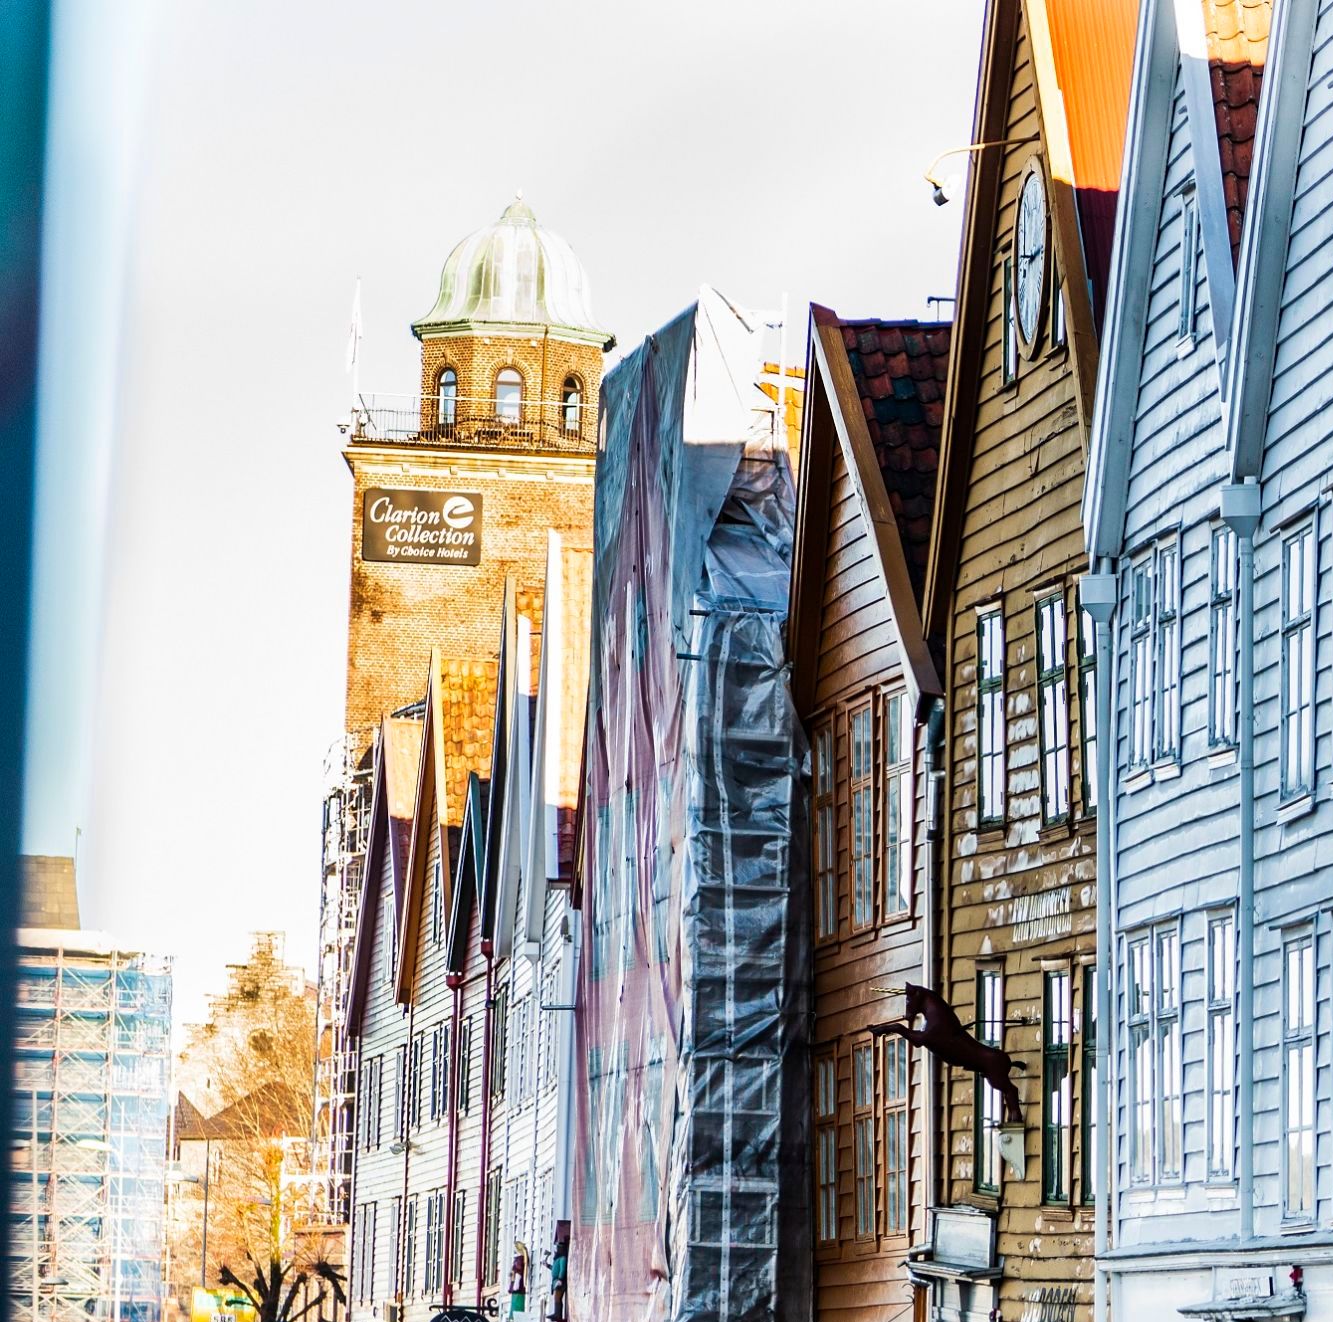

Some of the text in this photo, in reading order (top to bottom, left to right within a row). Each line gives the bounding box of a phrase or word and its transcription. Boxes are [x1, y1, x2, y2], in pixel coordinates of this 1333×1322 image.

[370, 496, 440, 525] Clarion
[385, 525, 475, 546] Collection
[387, 545, 469, 559] By Choice Hotels
